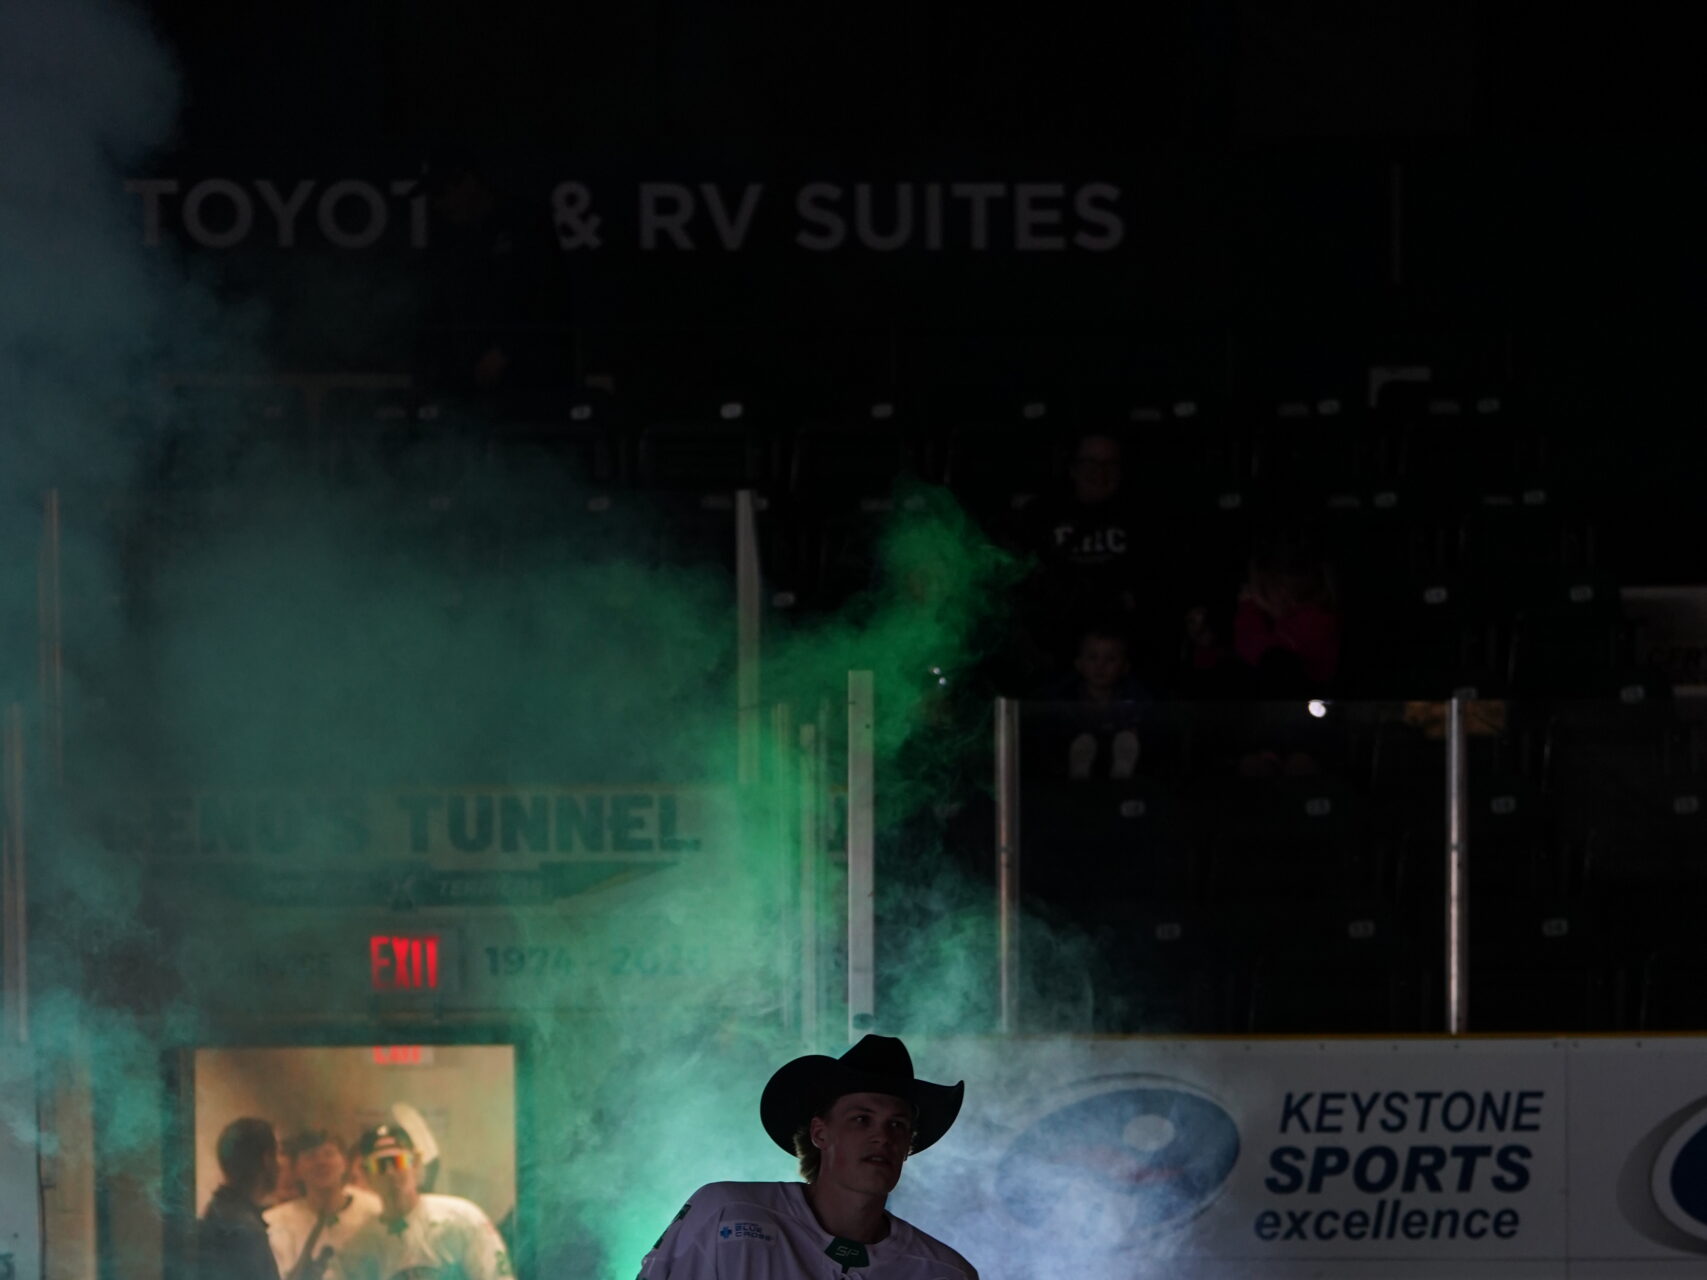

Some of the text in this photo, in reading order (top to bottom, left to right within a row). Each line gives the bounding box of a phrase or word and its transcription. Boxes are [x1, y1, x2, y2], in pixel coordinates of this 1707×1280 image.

[122, 177, 1127, 254] TOYOT & RV SUITES
[396, 794, 703, 853] TUNNEL
[369, 935, 440, 991] EXIT
[1279, 1090, 1545, 1134] KEYSTONE
[1264, 1144, 1534, 1195] SPORTS
[1253, 1200, 1521, 1241] excellence
